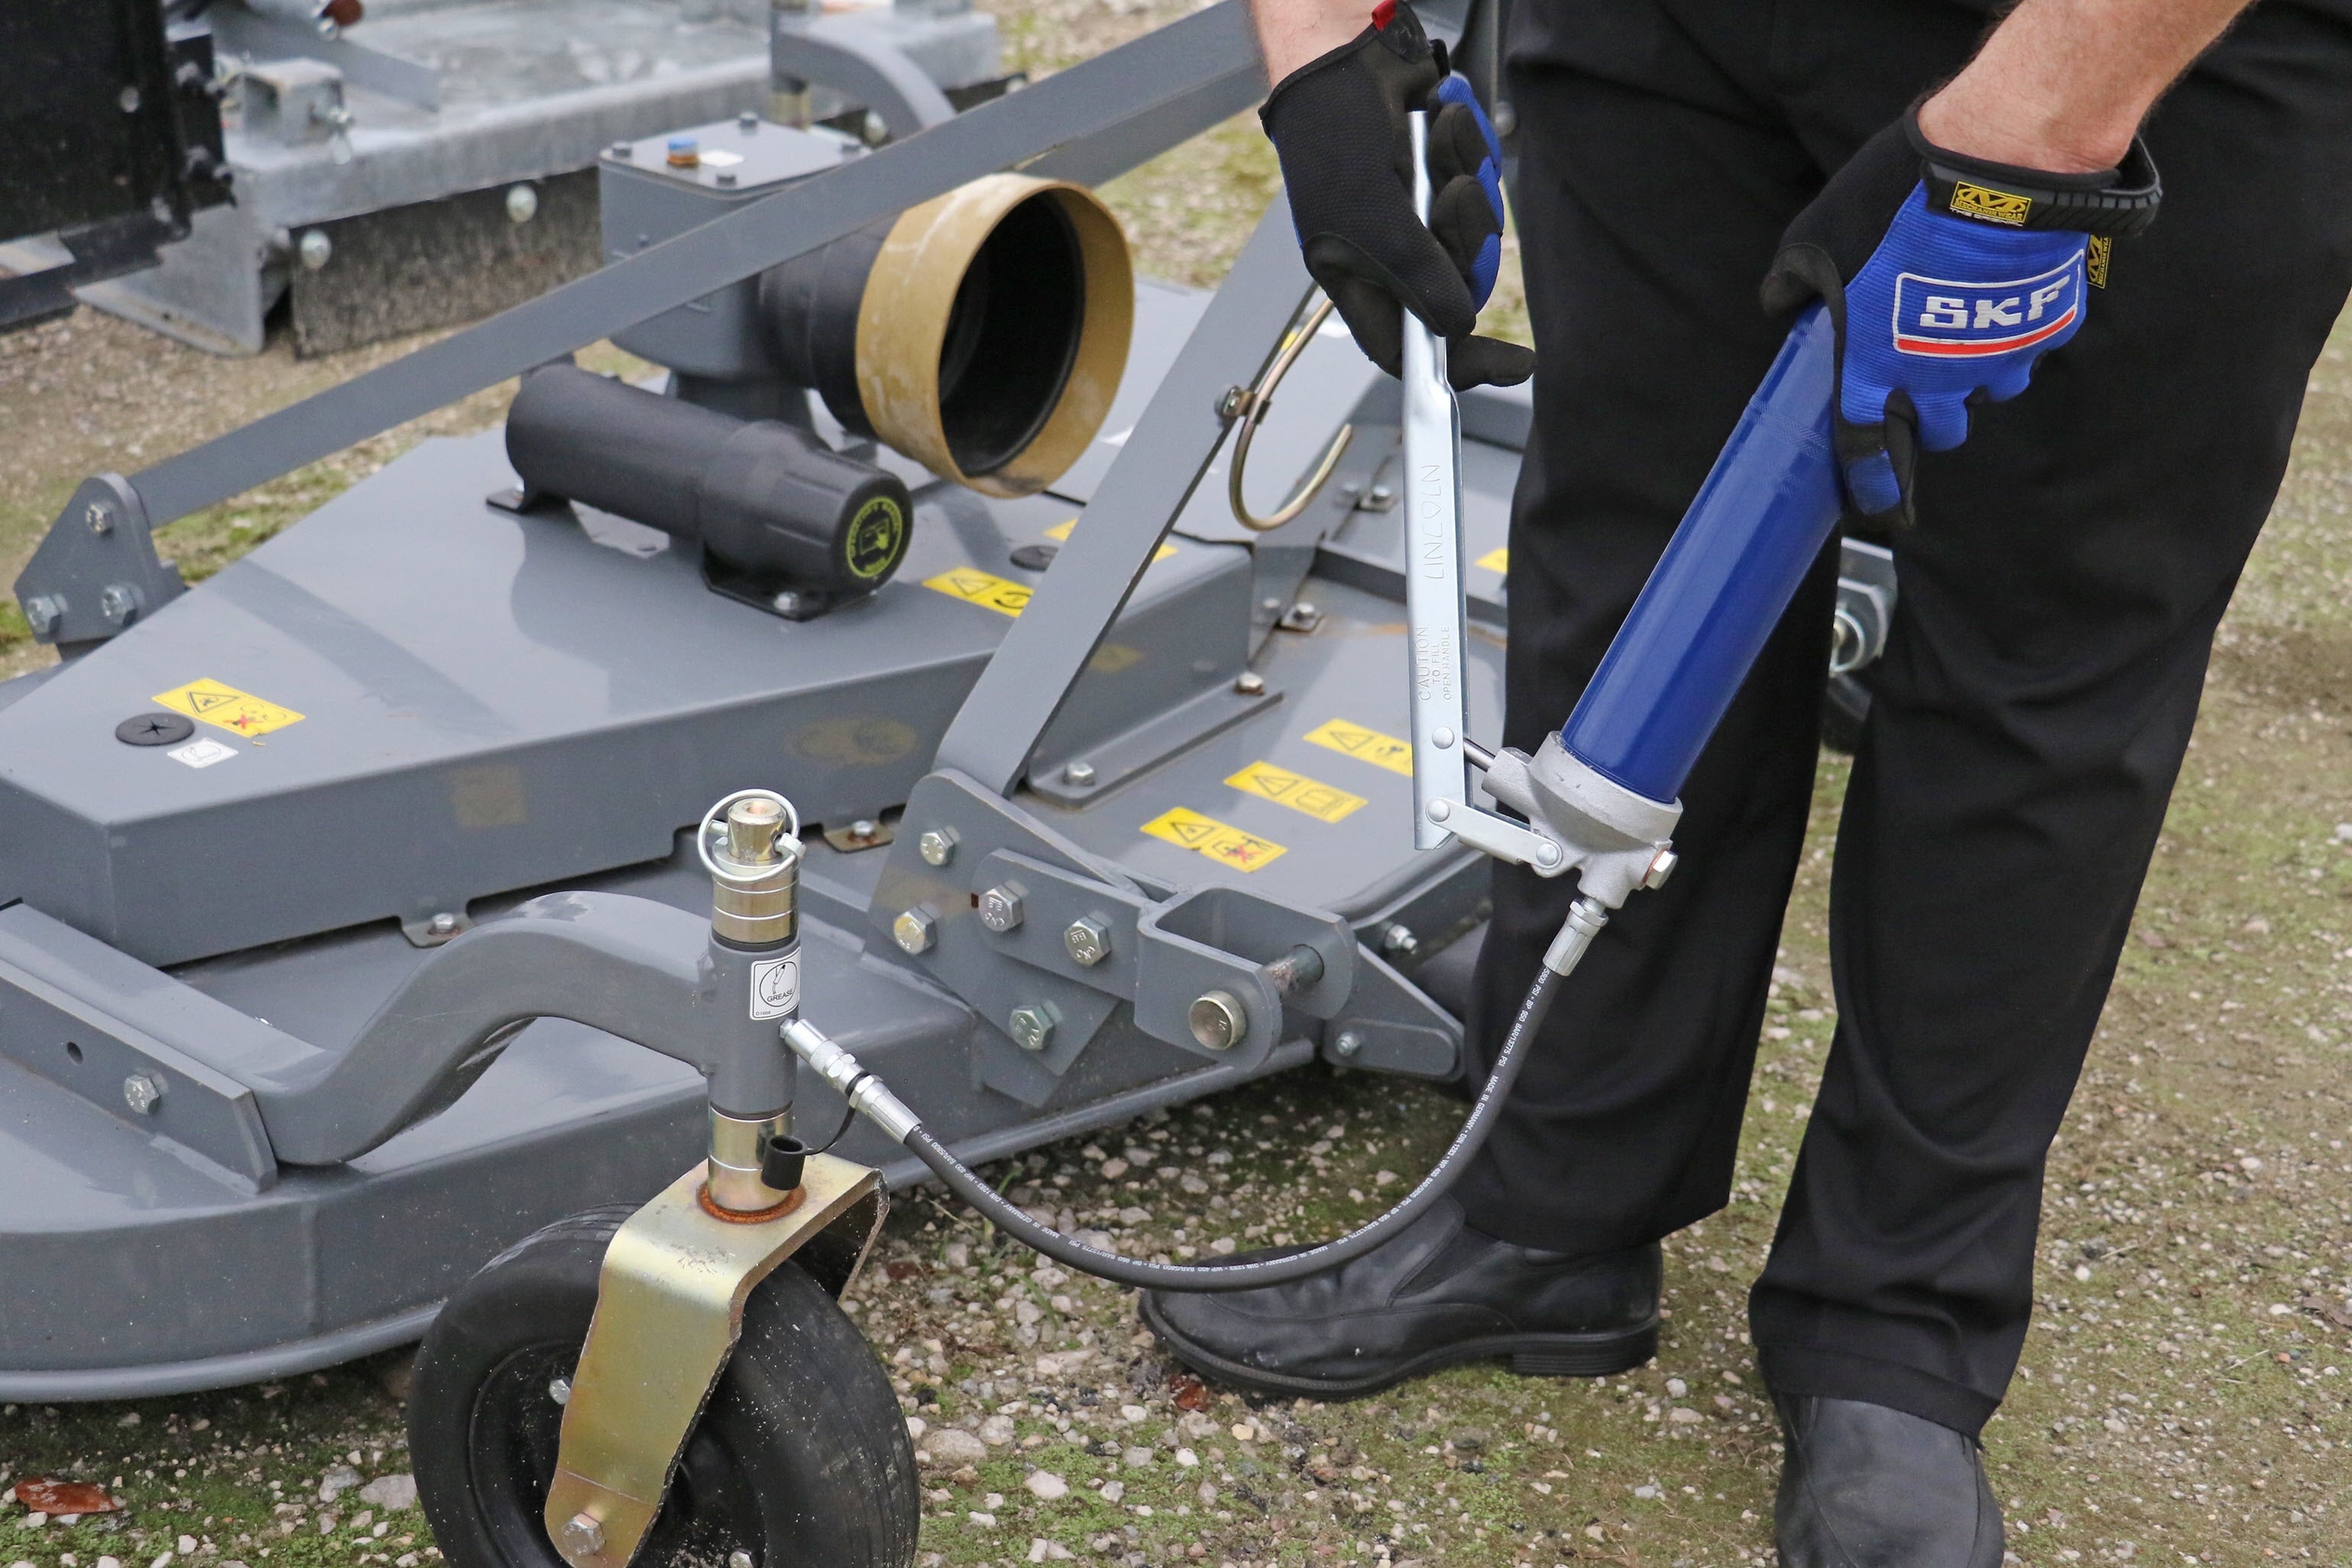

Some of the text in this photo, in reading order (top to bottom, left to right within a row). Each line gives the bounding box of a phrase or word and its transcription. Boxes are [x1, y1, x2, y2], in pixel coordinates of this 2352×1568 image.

[1954, 199, 2023, 221] MECHANIX WEAR
[1920, 274, 2070, 329] SKF
[1421, 465, 1444, 579] LINCOLN
[1416, 627, 1431, 701] CAUTION
[1441, 626, 1451, 701] OPEN HANDLE
[1432, 669, 1440, 685] TO
[766, 988, 793, 1003] GREASE
[1531, 984, 1541, 996] PSI
[1526, 999, 1534, 1009] BP
[1518, 1010, 1528, 1022] 950
[1498, 1055, 1508, 1067] PSI
[1485, 1074, 1498, 1093] MADE
[1481, 1093, 1489, 1102] IN
[1466, 1102, 1485, 1131] GERMANY
[922, 1132, 934, 1143] PSI
[1456, 1133, 1467, 1144] DIN
[931, 1142, 957, 1165] BAR/5800
[954, 1163, 967, 1173] 400
[1439, 1159, 1449, 1168] WP
[964, 1172, 976, 1182] WP
[990, 1193, 1002, 1202] DIN
[1003, 1204, 1033, 1223] GERMANY
[1041, 1226, 1061, 1239] MADE
